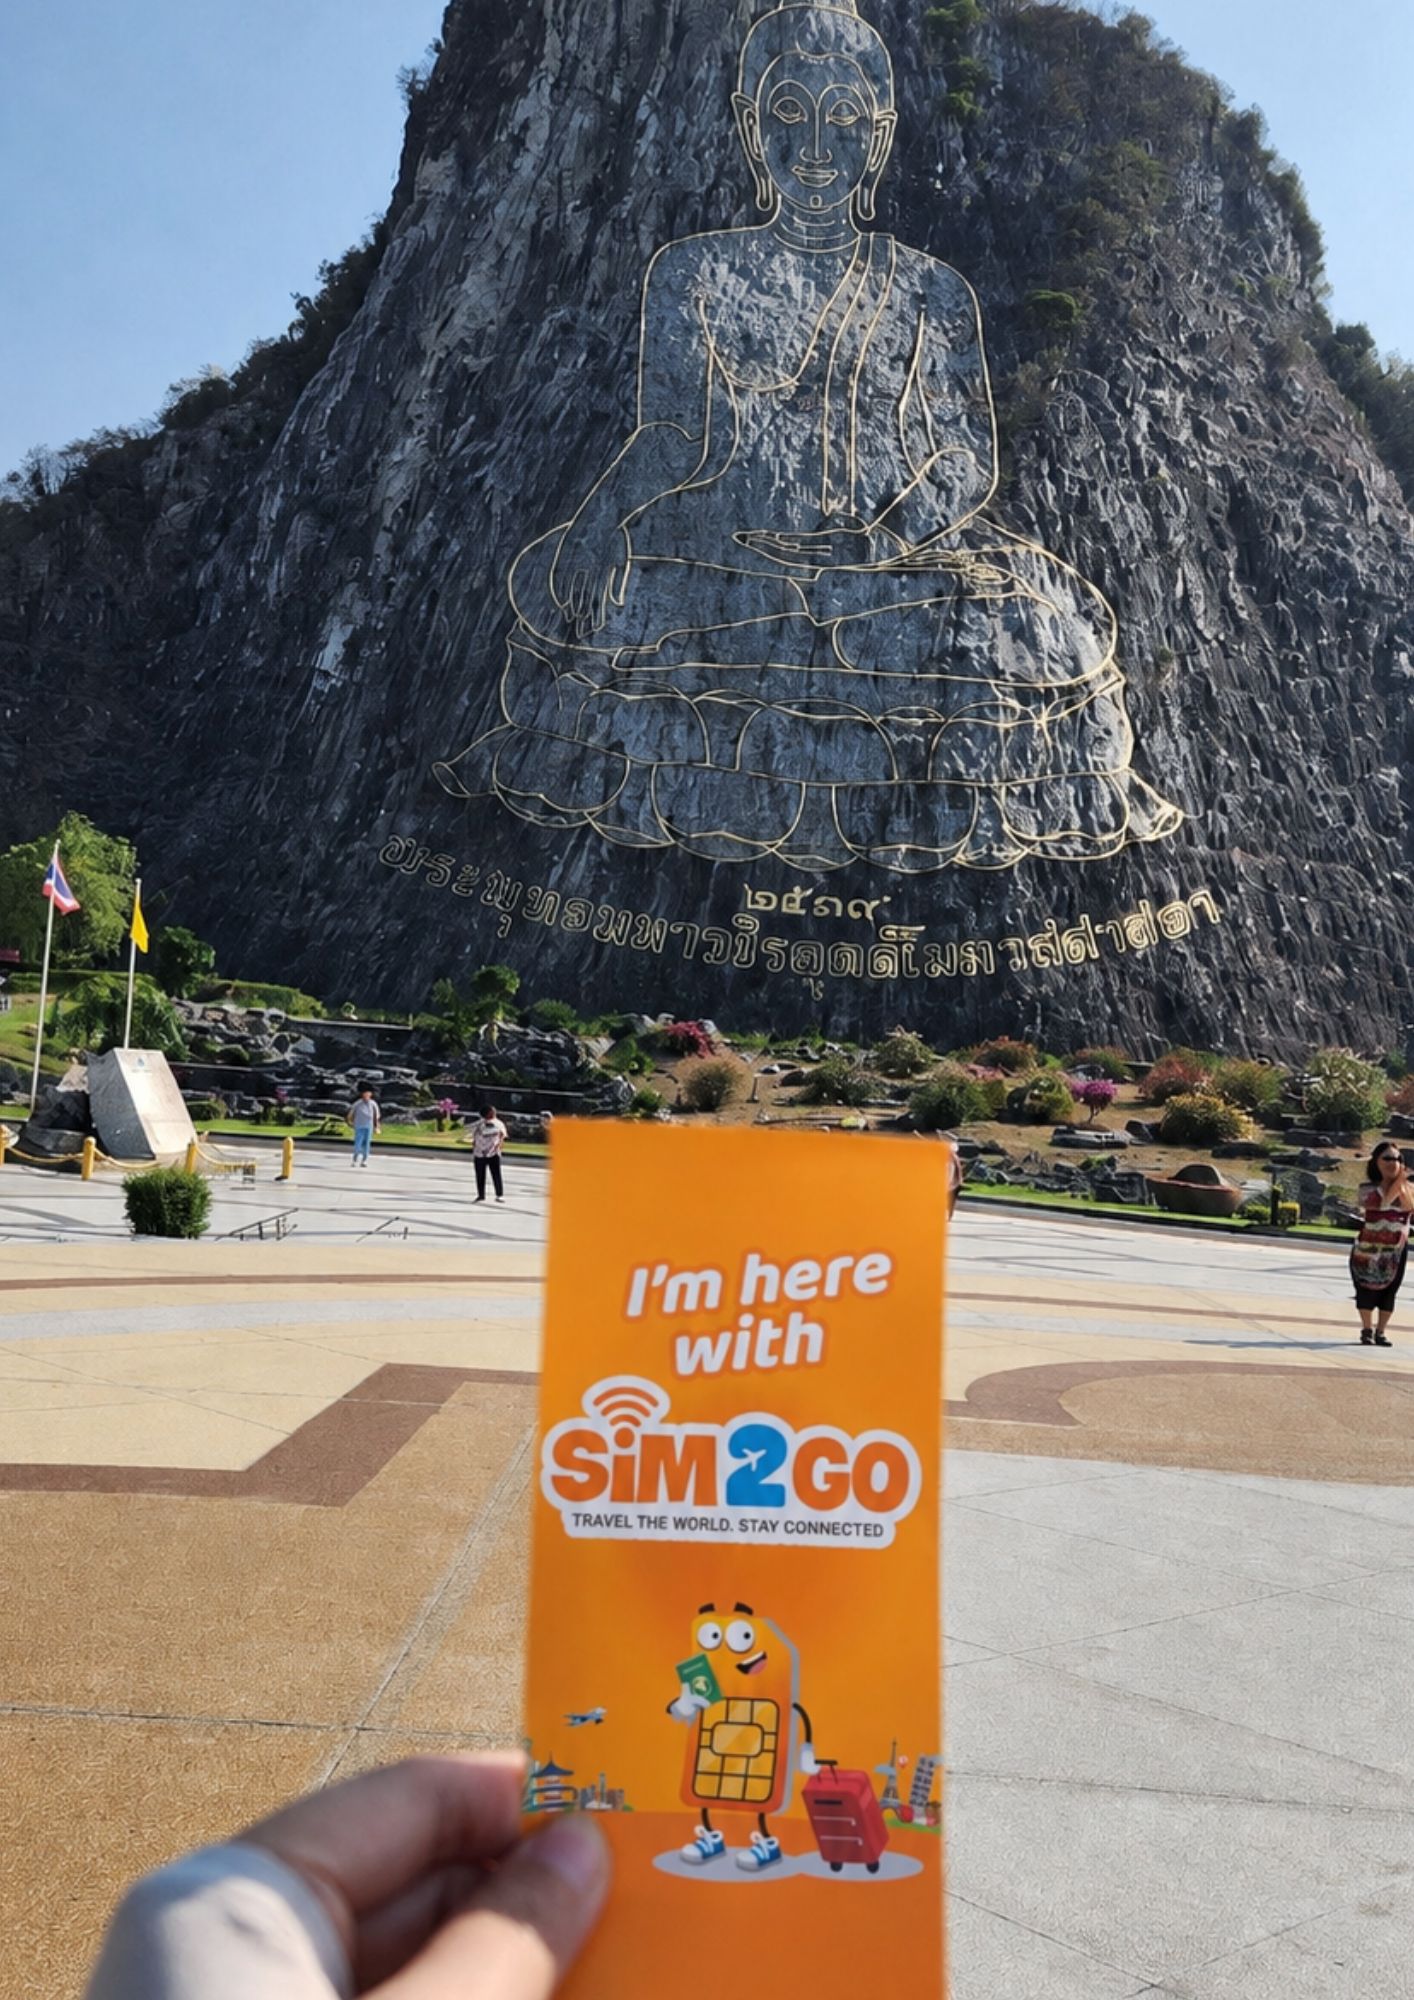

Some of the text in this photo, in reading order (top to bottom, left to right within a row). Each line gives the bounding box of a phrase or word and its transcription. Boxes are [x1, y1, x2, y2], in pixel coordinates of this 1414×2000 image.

[740, 1252, 892, 1305] here
[674, 1311, 824, 1376] with
[572, 1512, 885, 1538] TRAVEL THE WORLD. STAY CONNECTED
